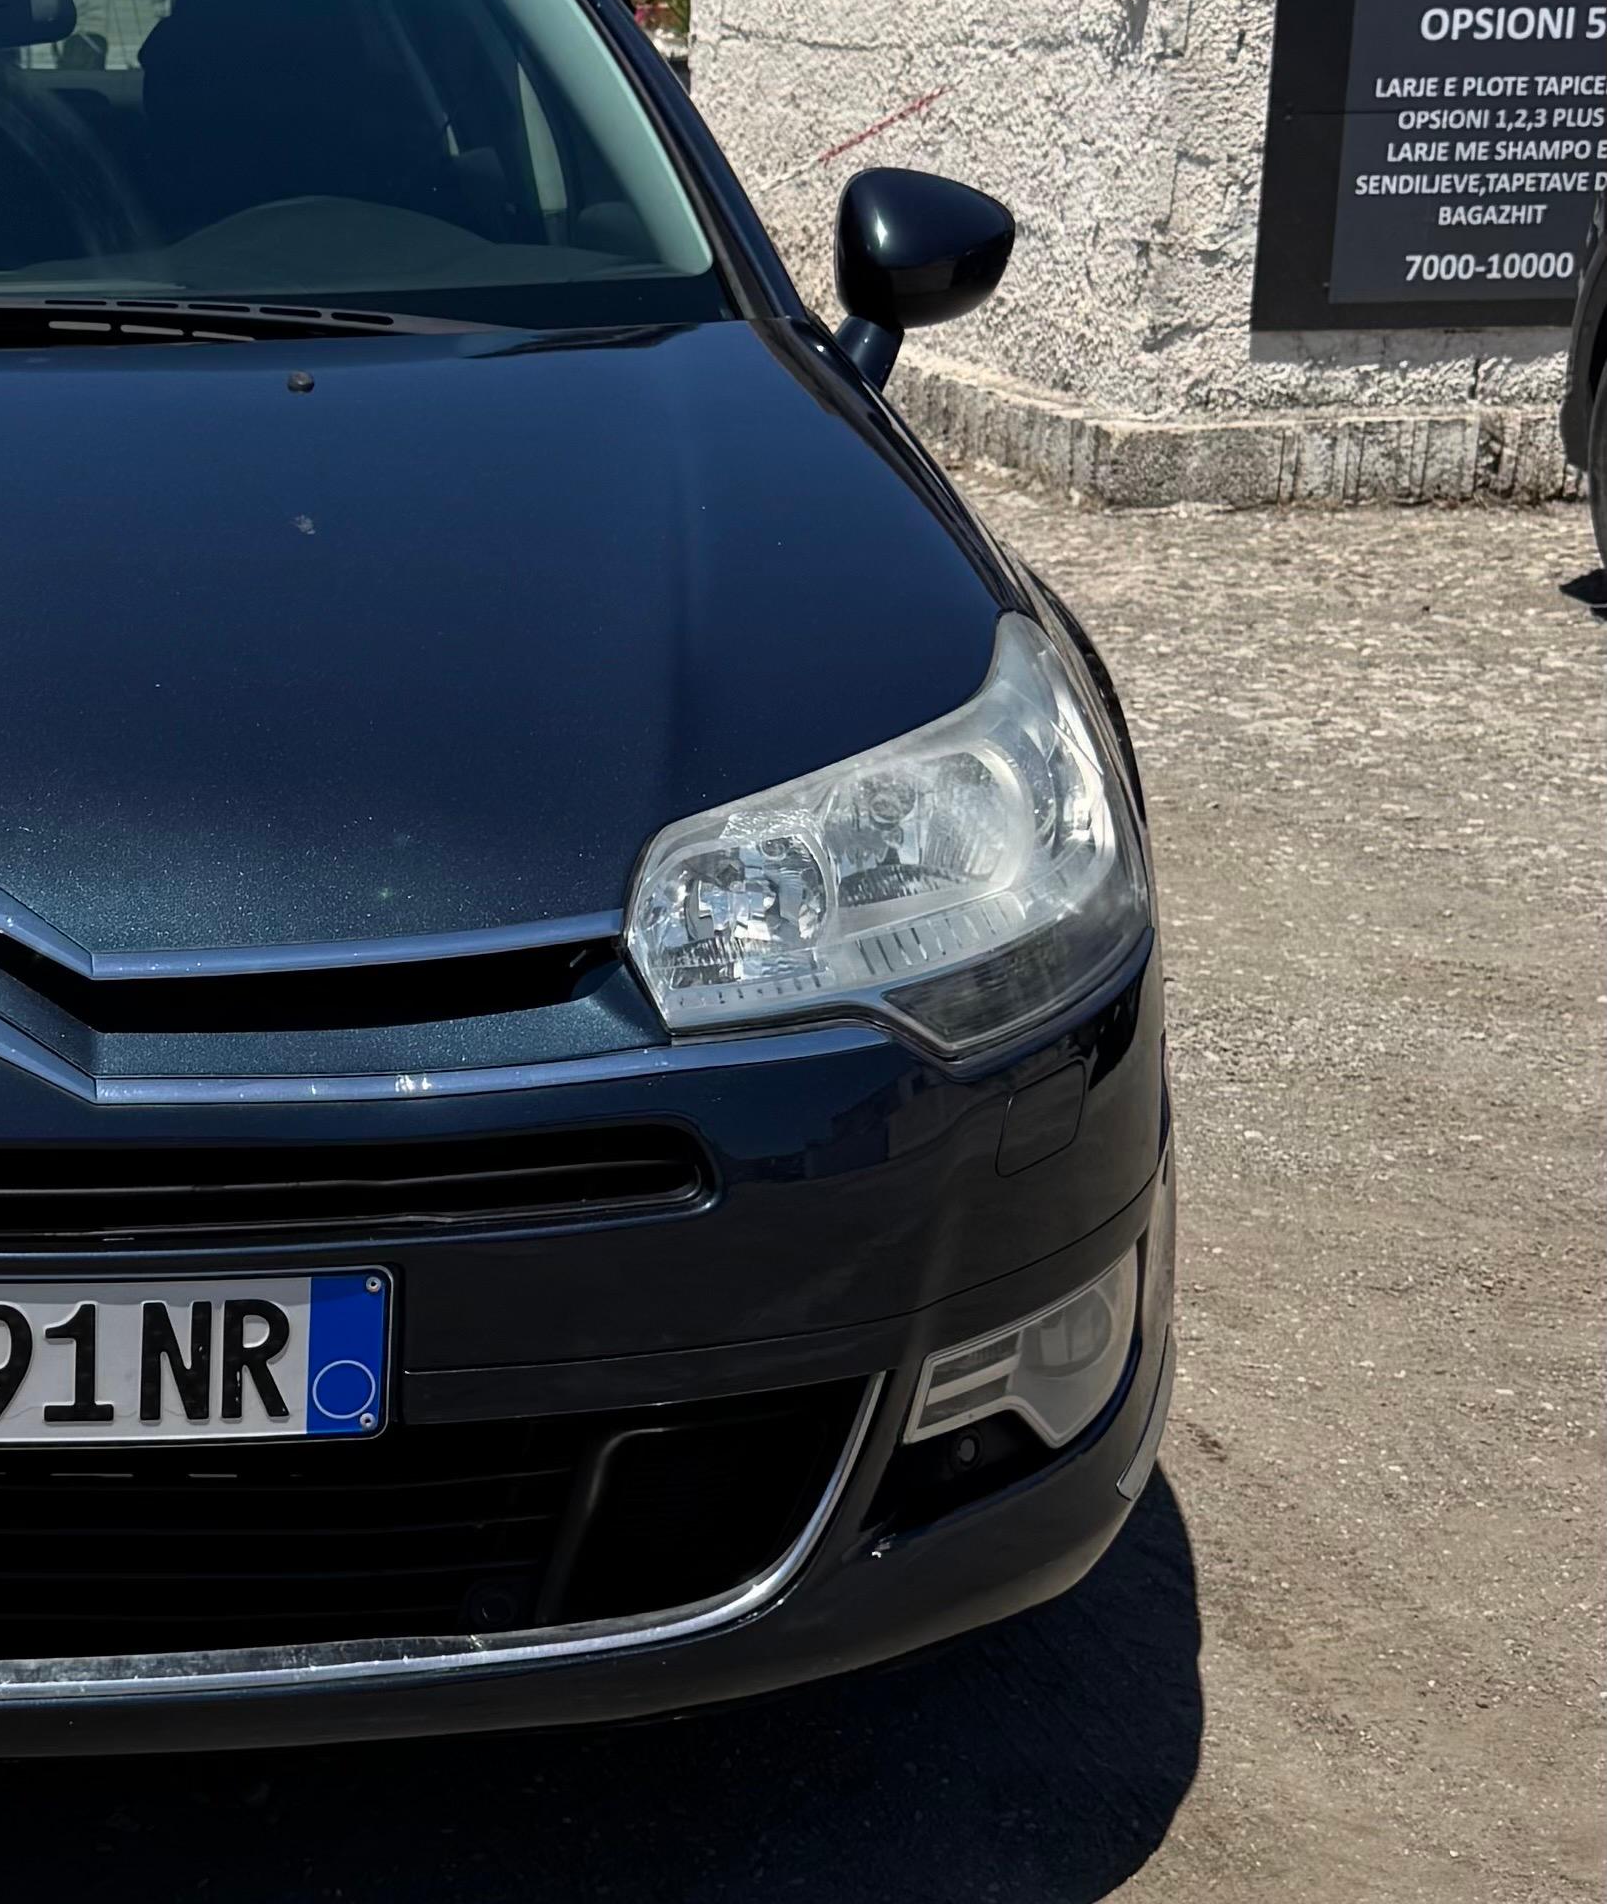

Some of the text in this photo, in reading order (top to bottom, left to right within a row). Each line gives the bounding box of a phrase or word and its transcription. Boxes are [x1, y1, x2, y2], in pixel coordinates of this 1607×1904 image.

[1420, 6, 1607, 41] OPSIONI 5
[1375, 75, 1607, 98] LARJE E PLOTE TAPICE
[1398, 107, 1605, 132] OPSIONI 1,2,3 PLUS
[1387, 142, 1449, 162] LARJE
[1454, 141, 1490, 162] ME
[1494, 140, 1592, 162] SHAMPO
[1438, 204, 1548, 226] BAGAZHIT
[1404, 252, 1575, 282] 7000-10000
